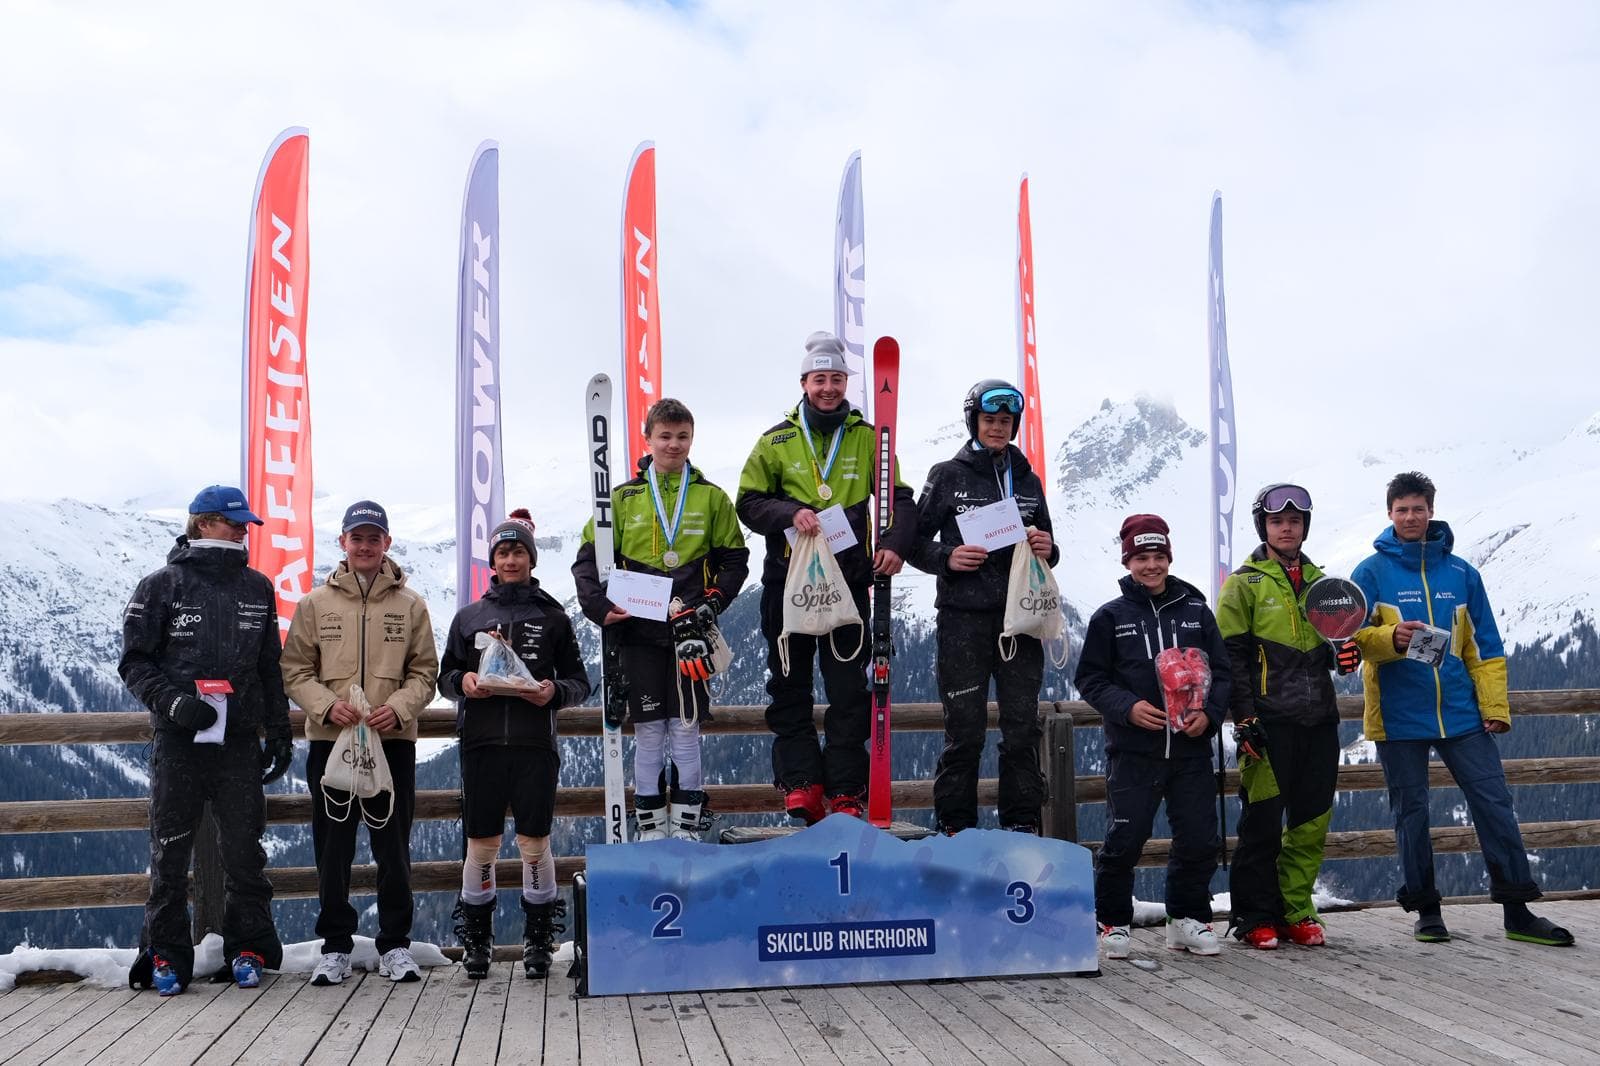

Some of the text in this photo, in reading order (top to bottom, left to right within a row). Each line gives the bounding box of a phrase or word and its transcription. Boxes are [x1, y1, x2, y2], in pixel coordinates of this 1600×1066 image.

[592, 415, 612, 529] HEAD
[351, 509, 383, 518] ANDRIST
[984, 524, 1018, 541] RAIFFEISEN
[627, 597, 663, 607] RAIFFEISEN
[830, 851, 850, 895] 1
[651, 893, 683, 939] 2
[1005, 880, 1035, 925] 3
[766, 927, 928, 954] SKICLUB RINERHORN
